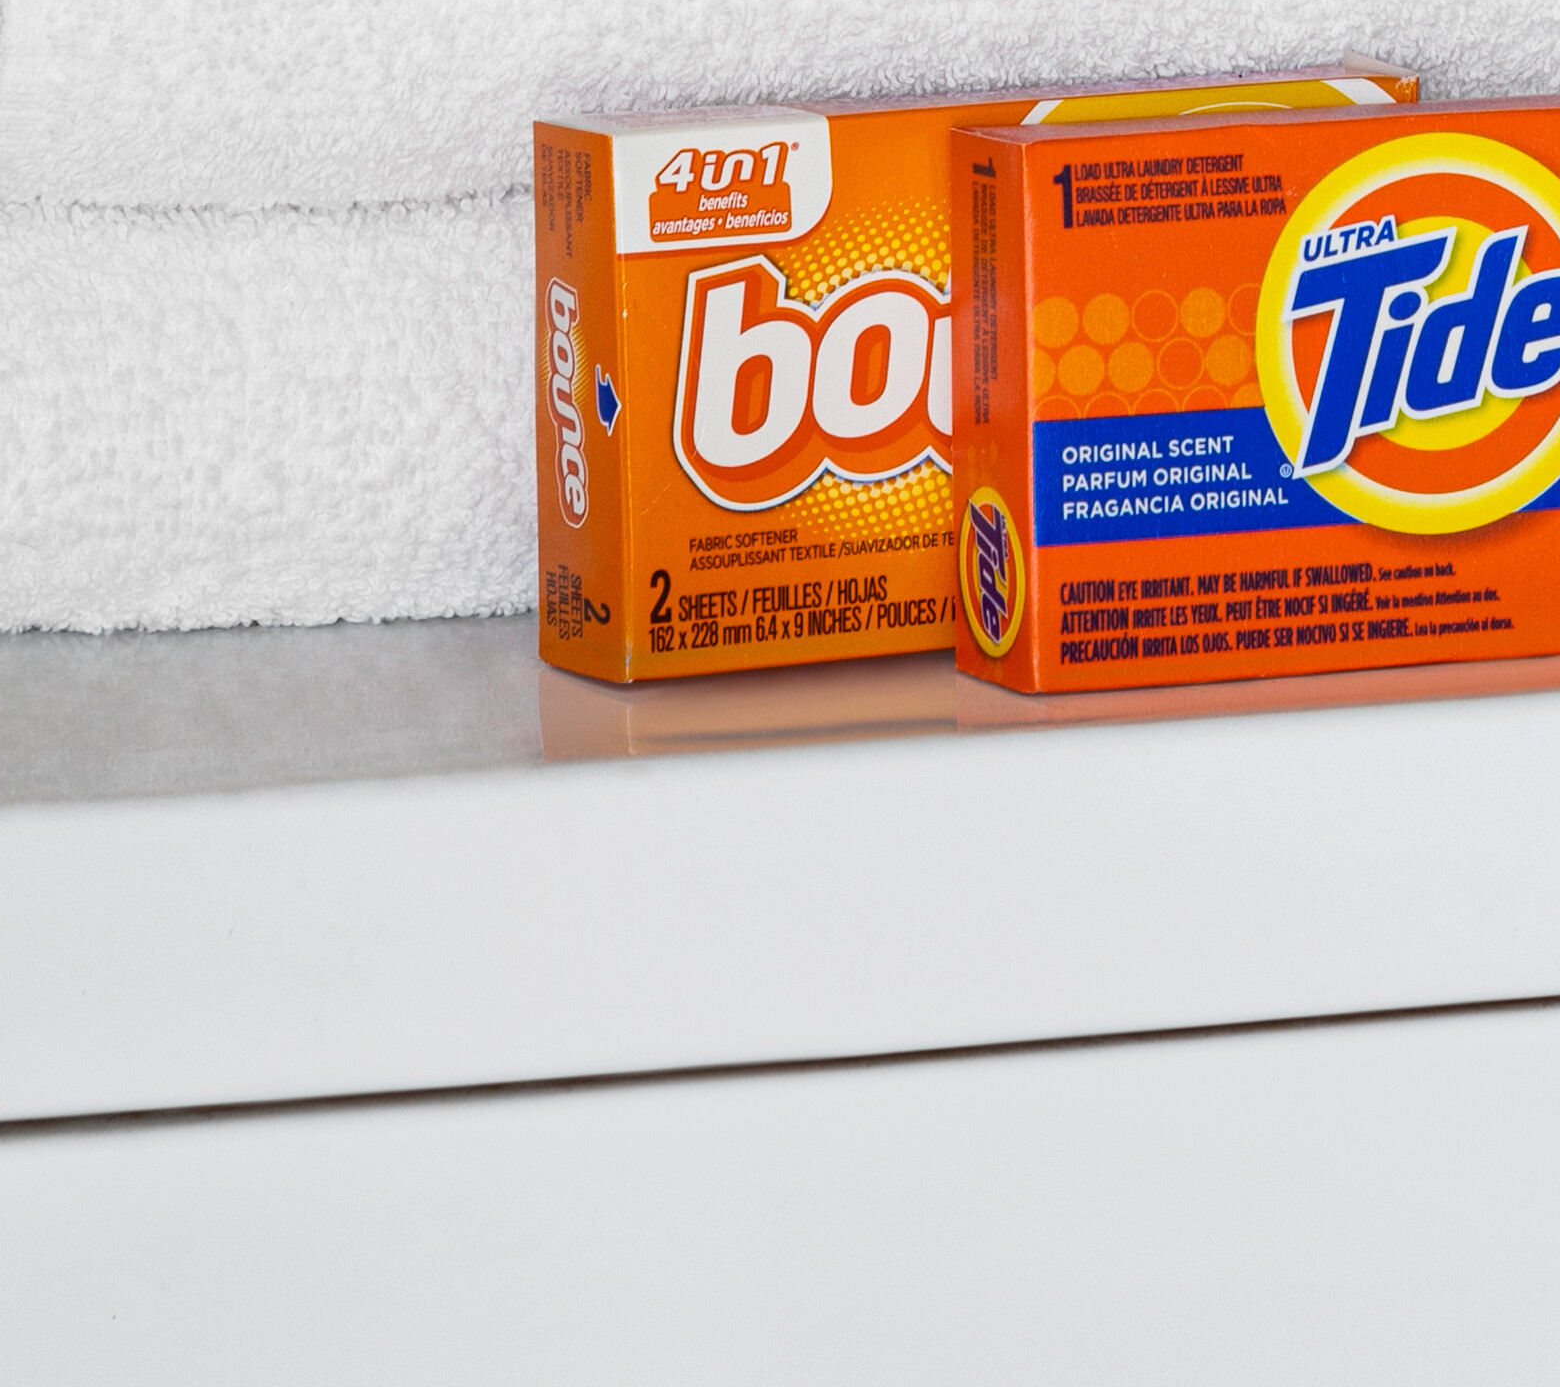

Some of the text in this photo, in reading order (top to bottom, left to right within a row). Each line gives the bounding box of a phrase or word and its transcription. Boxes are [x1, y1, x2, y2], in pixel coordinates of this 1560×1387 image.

[659, 144, 781, 192] 4in1
[1074, 154, 1243, 180] LOAD ULTRA LAUNDRY DETERGENT
[698, 192, 748, 212] benefits
[1053, 164, 1073, 229] 1
[1076, 181, 1121, 203] BRASSÉE
[1124, 184, 1137, 201] DE
[1141, 178, 1198, 200] DÉTERGENT
[1210, 177, 1250, 196] LESSIVE
[1252, 175, 1282, 193] ULTRA
[652, 208, 789, 236] avantages beneficios
[1076, 197, 1286, 227] LAVADA DETERGENTE ULTRA PARA LA ROPA
[1303, 219, 1395, 262] ULTRA
[692, 279, 953, 468] bo
[548, 281, 587, 519] bounce
[1062, 435, 1234, 464] ORIGINAL SCENT
[1062, 462, 1252, 493] PARFUM ORIGINAL
[1062, 487, 1289, 521] FRAGANCIA ORIGINAL
[689, 529, 798, 553] FABRIC SOFTENER
[690, 548, 786, 572] ASSOUPLISSANT
[790, 543, 836, 561] TEXTILE
[922, 533, 939, 548] DE
[970, 500, 1008, 643] Tide
[1060, 579, 1115, 605] CAUTION
[1118, 580, 1138, 601] EYE
[1141, 577, 1194, 599] IRRITANT.
[1197, 574, 1220, 595] MAY
[1223, 572, 1236, 593] BE
[1240, 569, 1289, 591] HARMFUL
[1293, 567, 1302, 588] IF
[1305, 562, 1377, 587] SWALLOWED.
[1379, 567, 1392, 581] See
[1394, 565, 1421, 581] caution
[1424, 566, 1434, 577] on
[546, 571, 557, 626] HOJAS
[558, 565, 570, 641] FEUILLES
[571, 574, 583, 638] SHEETS
[584, 598, 610, 625] 2
[650, 569, 672, 624] 2
[678, 590, 737, 622] SHEETS
[753, 582, 822, 614] FEUILLES
[837, 575, 888, 606] HOJAS
[1061, 607, 1129, 635] ATTENTION
[1133, 607, 1167, 629] IRRITE
[1170, 605, 1187, 626] LES
[1190, 603, 1222, 624] YEUX.
[1226, 600, 1252, 622] PEUT
[1255, 596, 1281, 619] ÊTRE
[1285, 595, 1316, 617] NOCIF
[1319, 594, 1328, 615] SI
[1331, 587, 1373, 614] INGÉRÉ.
[1435, 588, 1471, 605] Attention
[648, 625, 675, 654] 162
[678, 631, 687, 651] x
[691, 621, 719, 649] 228
[723, 624, 752, 646] mm
[756, 615, 777, 642] 6.4
[781, 620, 791, 639] x
[794, 612, 803, 638] 9
[808, 606, 861, 637] INCHES
[877, 598, 937, 629] POUCES
[1061, 632, 1138, 664] PRECAUCIÓN
[1142, 636, 1177, 657] IRRITA
[1180, 634, 1199, 655] LOS
[1202, 631, 1233, 653] OJOS.
[1236, 629, 1271, 650] PUEDE
[1274, 627, 1293, 647] SER
[1296, 624, 1336, 645] NOCIVO
[1339, 622, 1349, 642] SI
[1352, 621, 1365, 641] SE
[1367, 618, 1413, 640] INGIERE.
